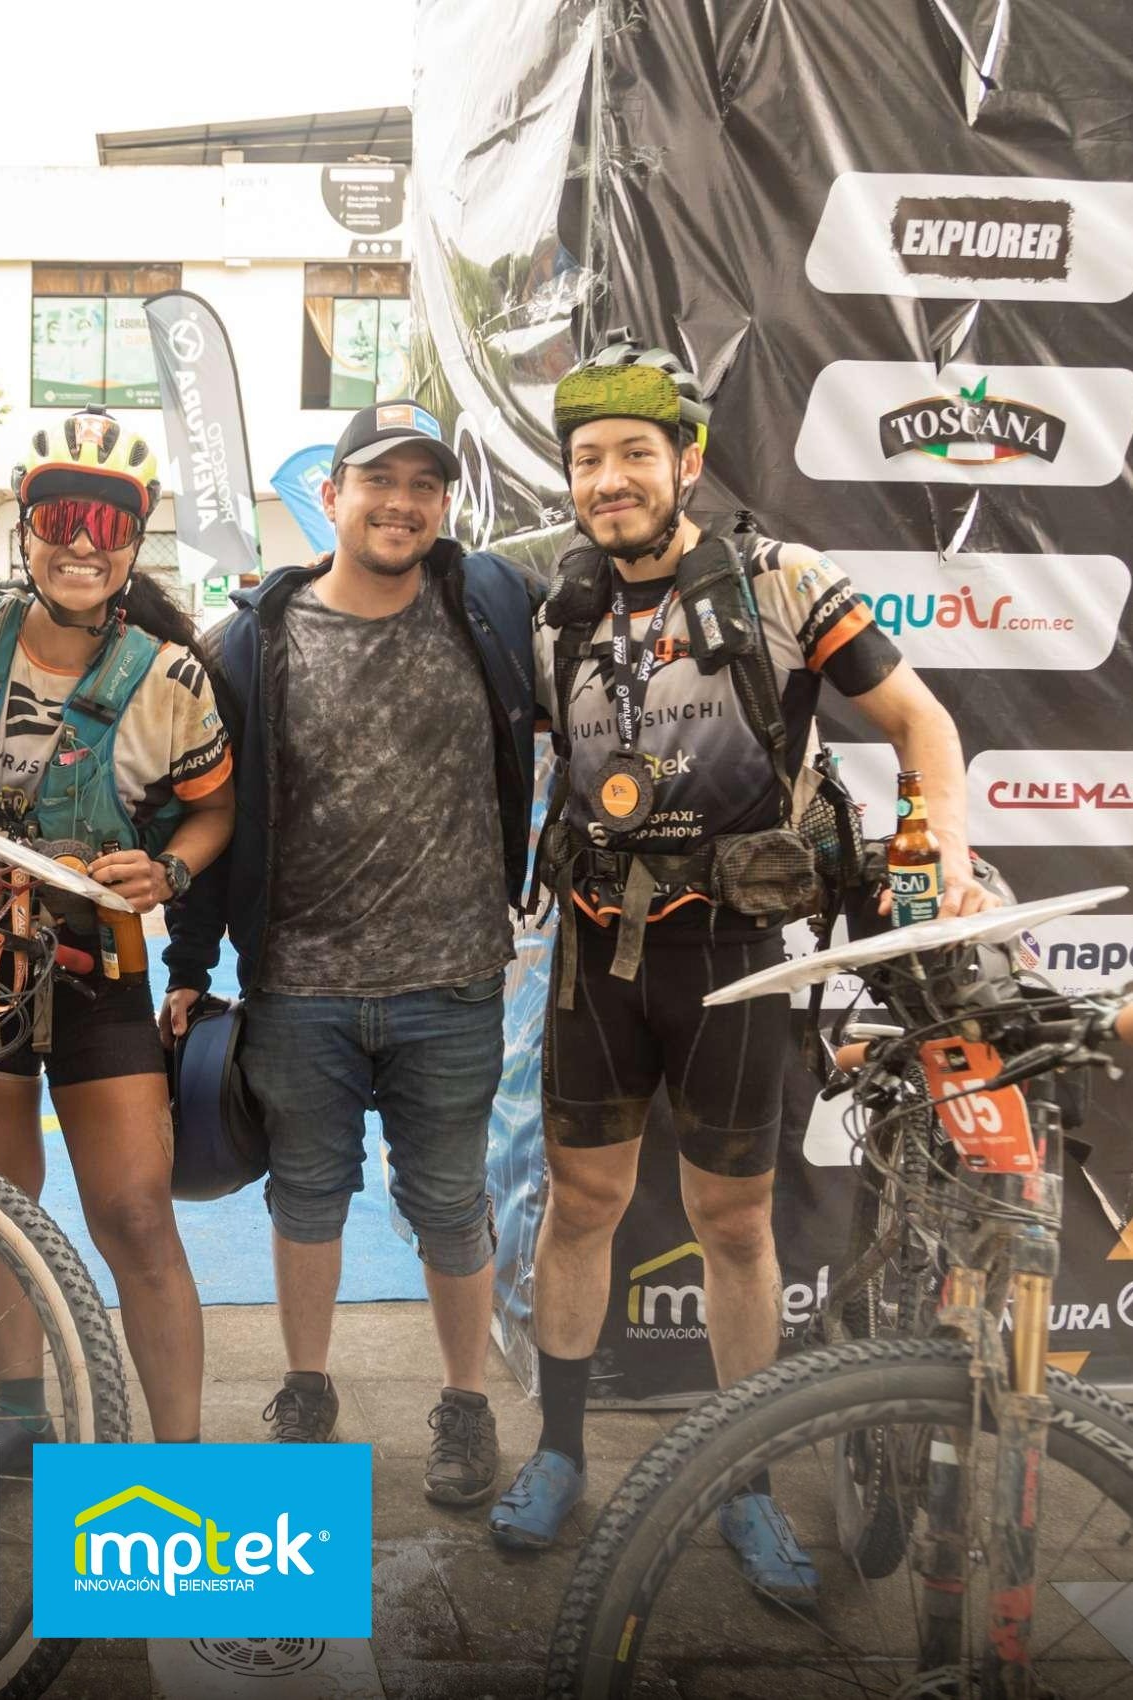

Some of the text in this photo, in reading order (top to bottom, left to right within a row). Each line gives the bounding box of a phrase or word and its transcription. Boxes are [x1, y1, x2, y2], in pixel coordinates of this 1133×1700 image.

[901, 219, 1063, 260] EXPLORER
[890, 405, 1048, 452] TOSCANA
[572, 702, 723, 742] HUAISINCHI
[1048, 942, 1133, 976] nap
[942, 1078, 1003, 1133] 05
[626, 1326, 708, 1340] INNOVACIÓN
